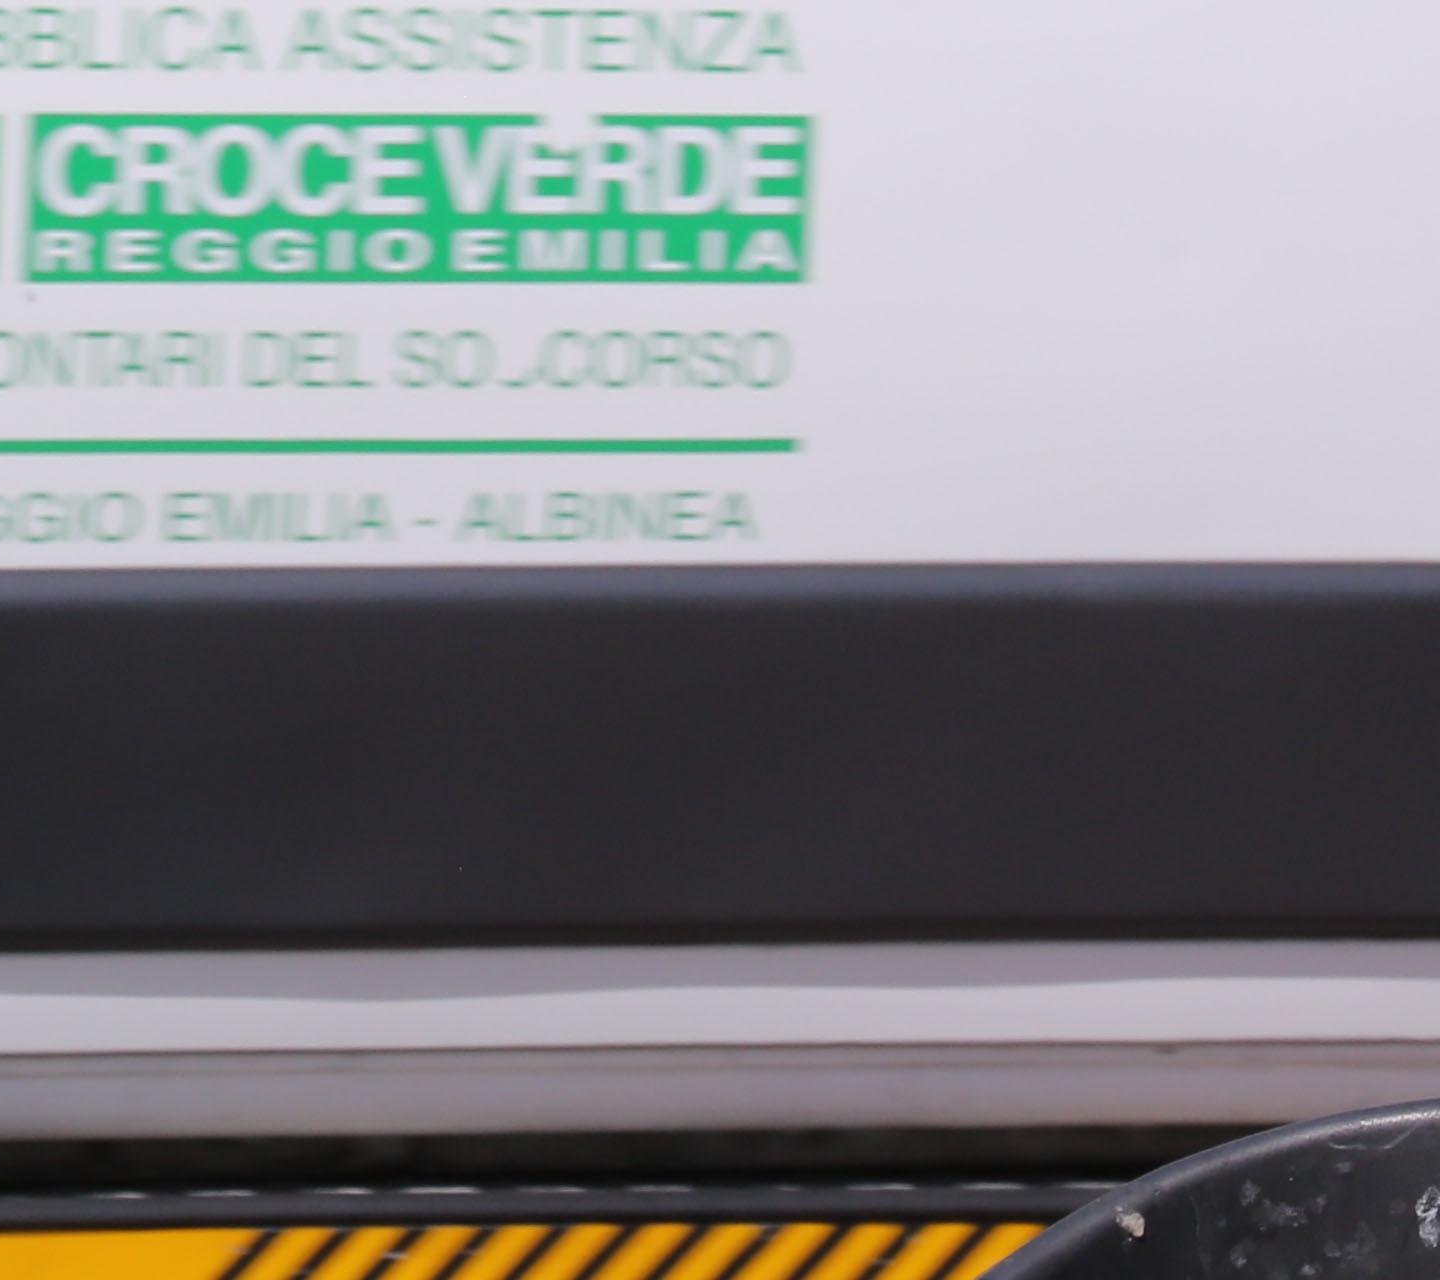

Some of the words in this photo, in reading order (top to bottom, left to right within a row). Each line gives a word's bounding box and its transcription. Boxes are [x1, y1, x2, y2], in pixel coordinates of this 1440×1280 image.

[276, 9, 804, 75] ASSISTENZA
[31, 230, 438, 273] REGGIO
[448, 230, 802, 274] EMILIA
[242, 332, 376, 388] DEL
[393, 332, 793, 389] SOCORSO
[159, 490, 397, 544] EMILIA
[453, 490, 759, 544] ALBINEA
